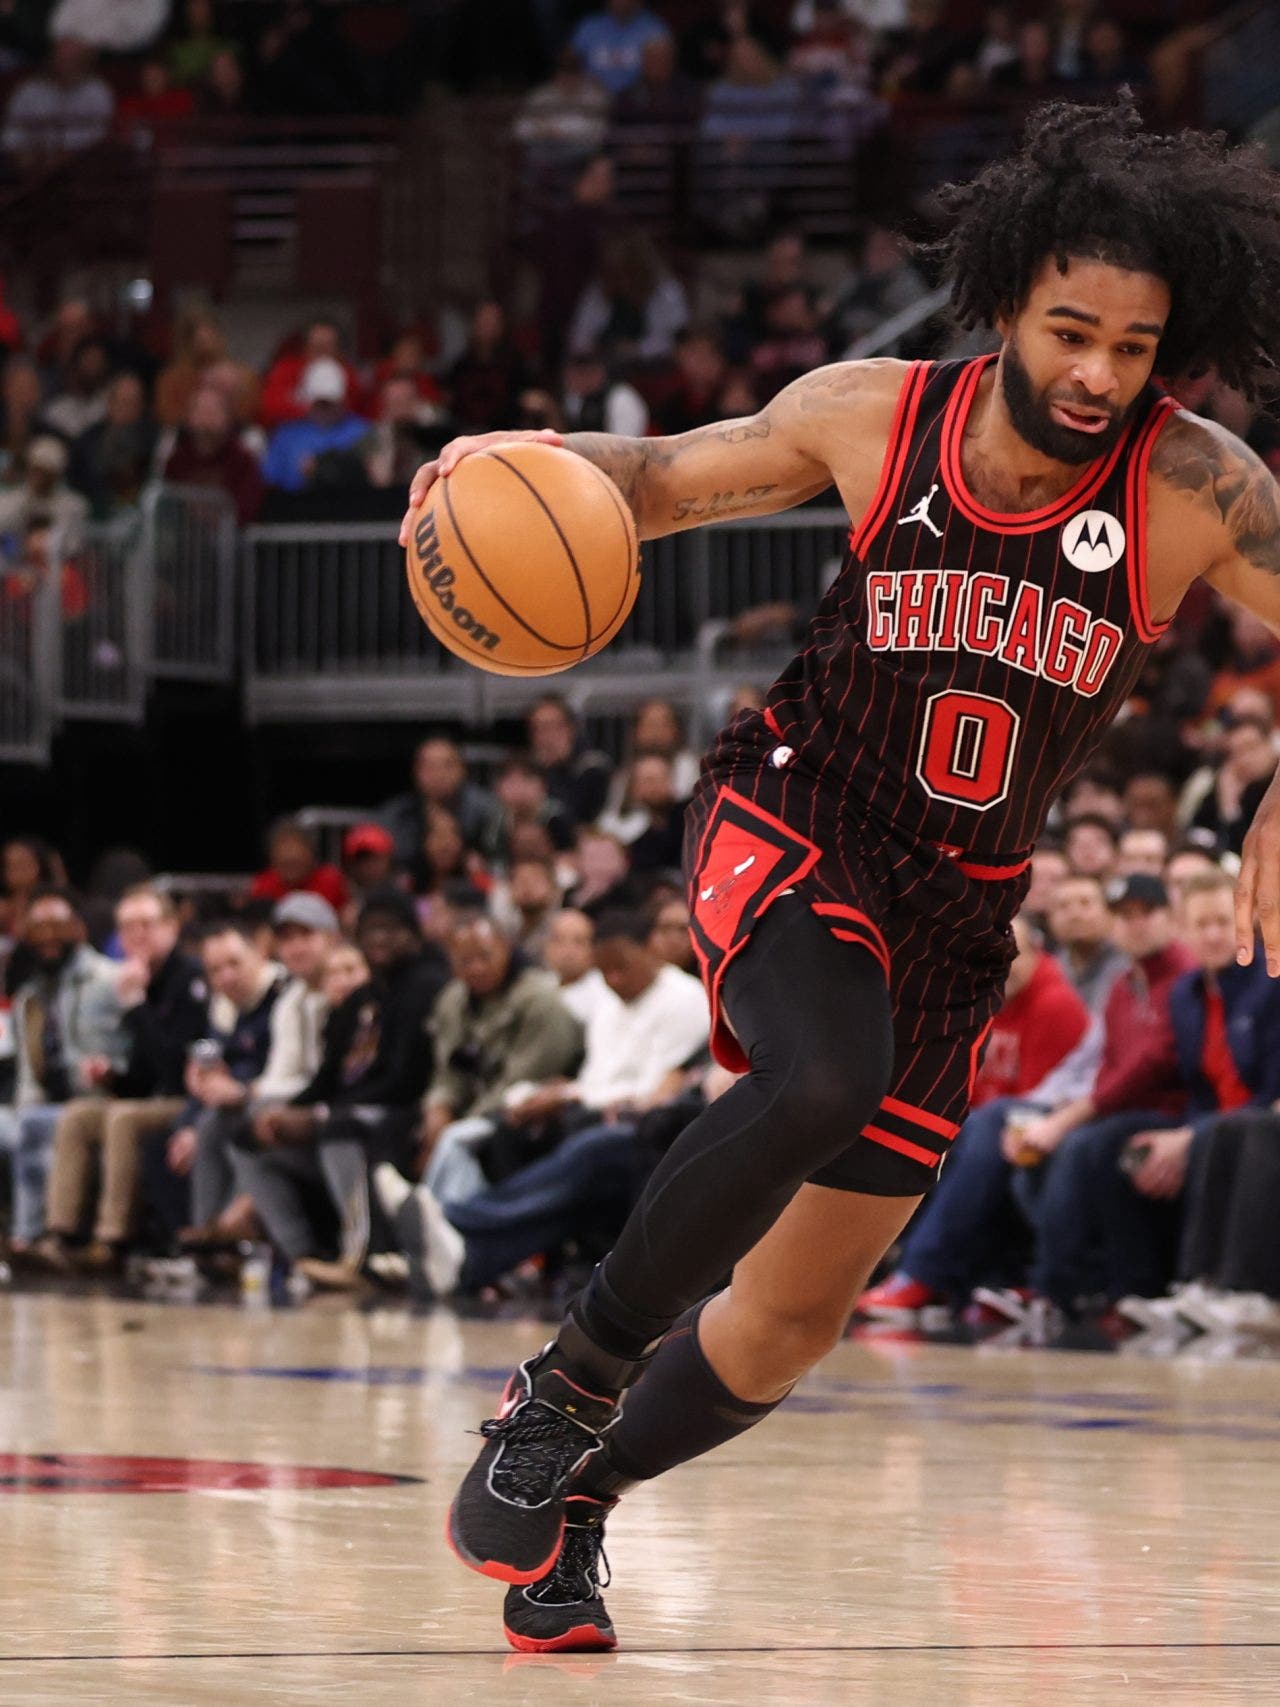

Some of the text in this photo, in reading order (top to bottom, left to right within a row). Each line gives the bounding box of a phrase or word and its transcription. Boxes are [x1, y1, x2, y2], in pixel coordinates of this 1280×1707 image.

[415, 508, 501, 650] Wilson
[866, 570, 1124, 698] CHICAGO
[915, 689, 1021, 811] 0
